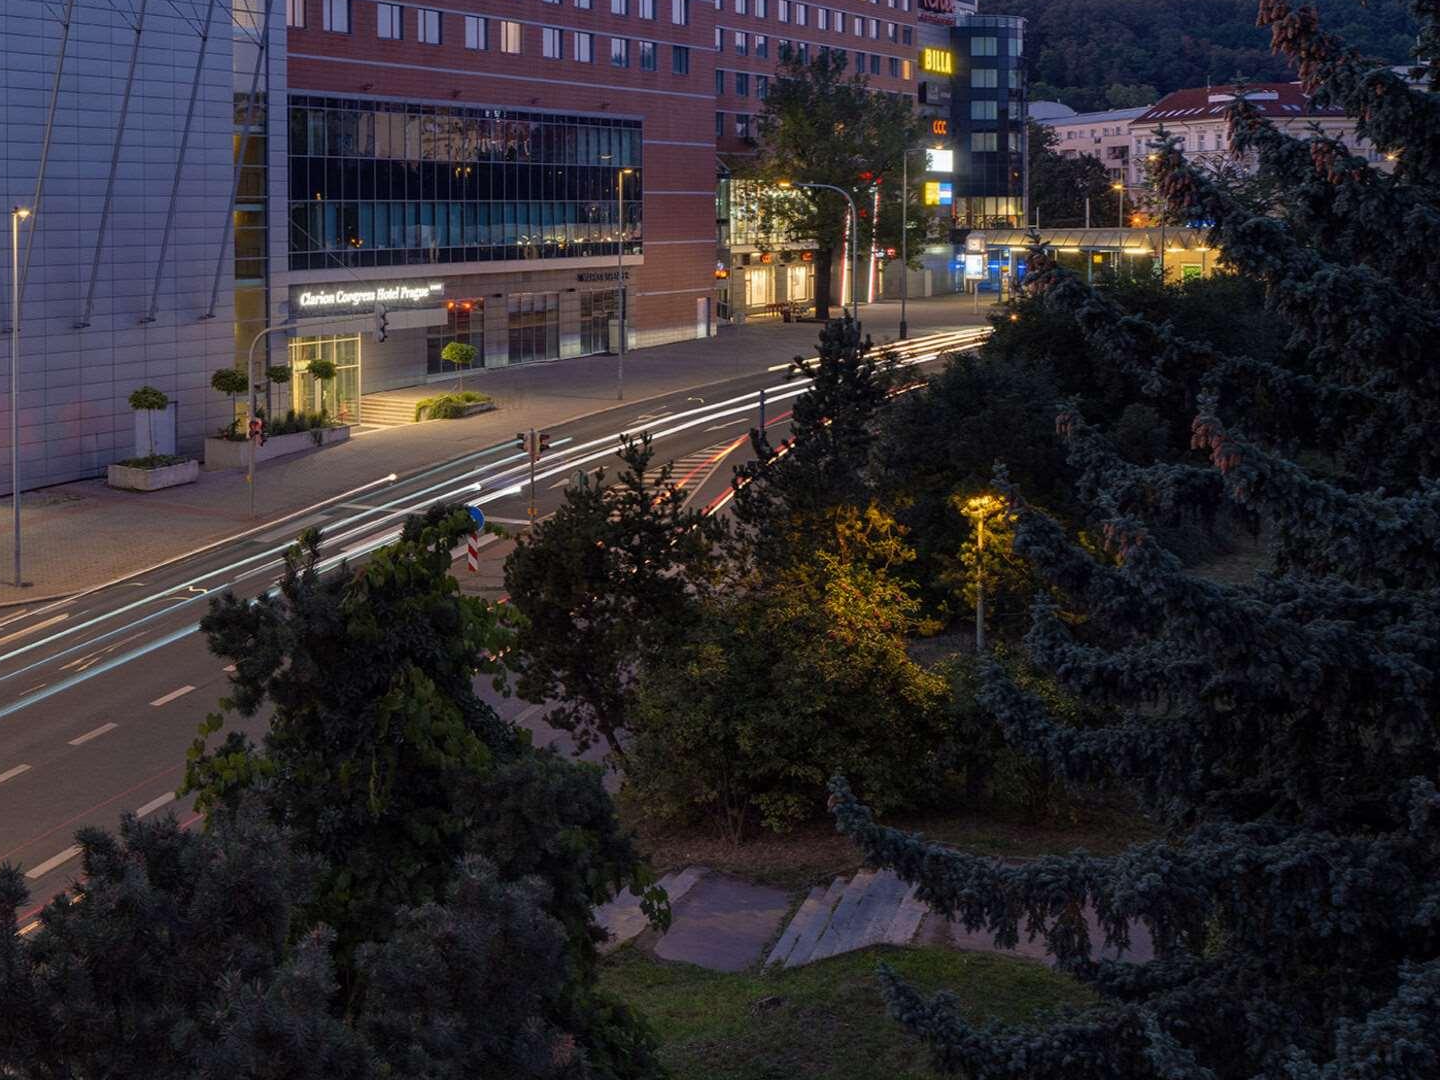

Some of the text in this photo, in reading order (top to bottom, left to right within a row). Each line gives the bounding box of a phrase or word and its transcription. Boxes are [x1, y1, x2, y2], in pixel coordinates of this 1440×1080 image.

[924, 47, 952, 74] BILLA
[300, 285, 430, 306] Clarion Congress Hotel Prague
